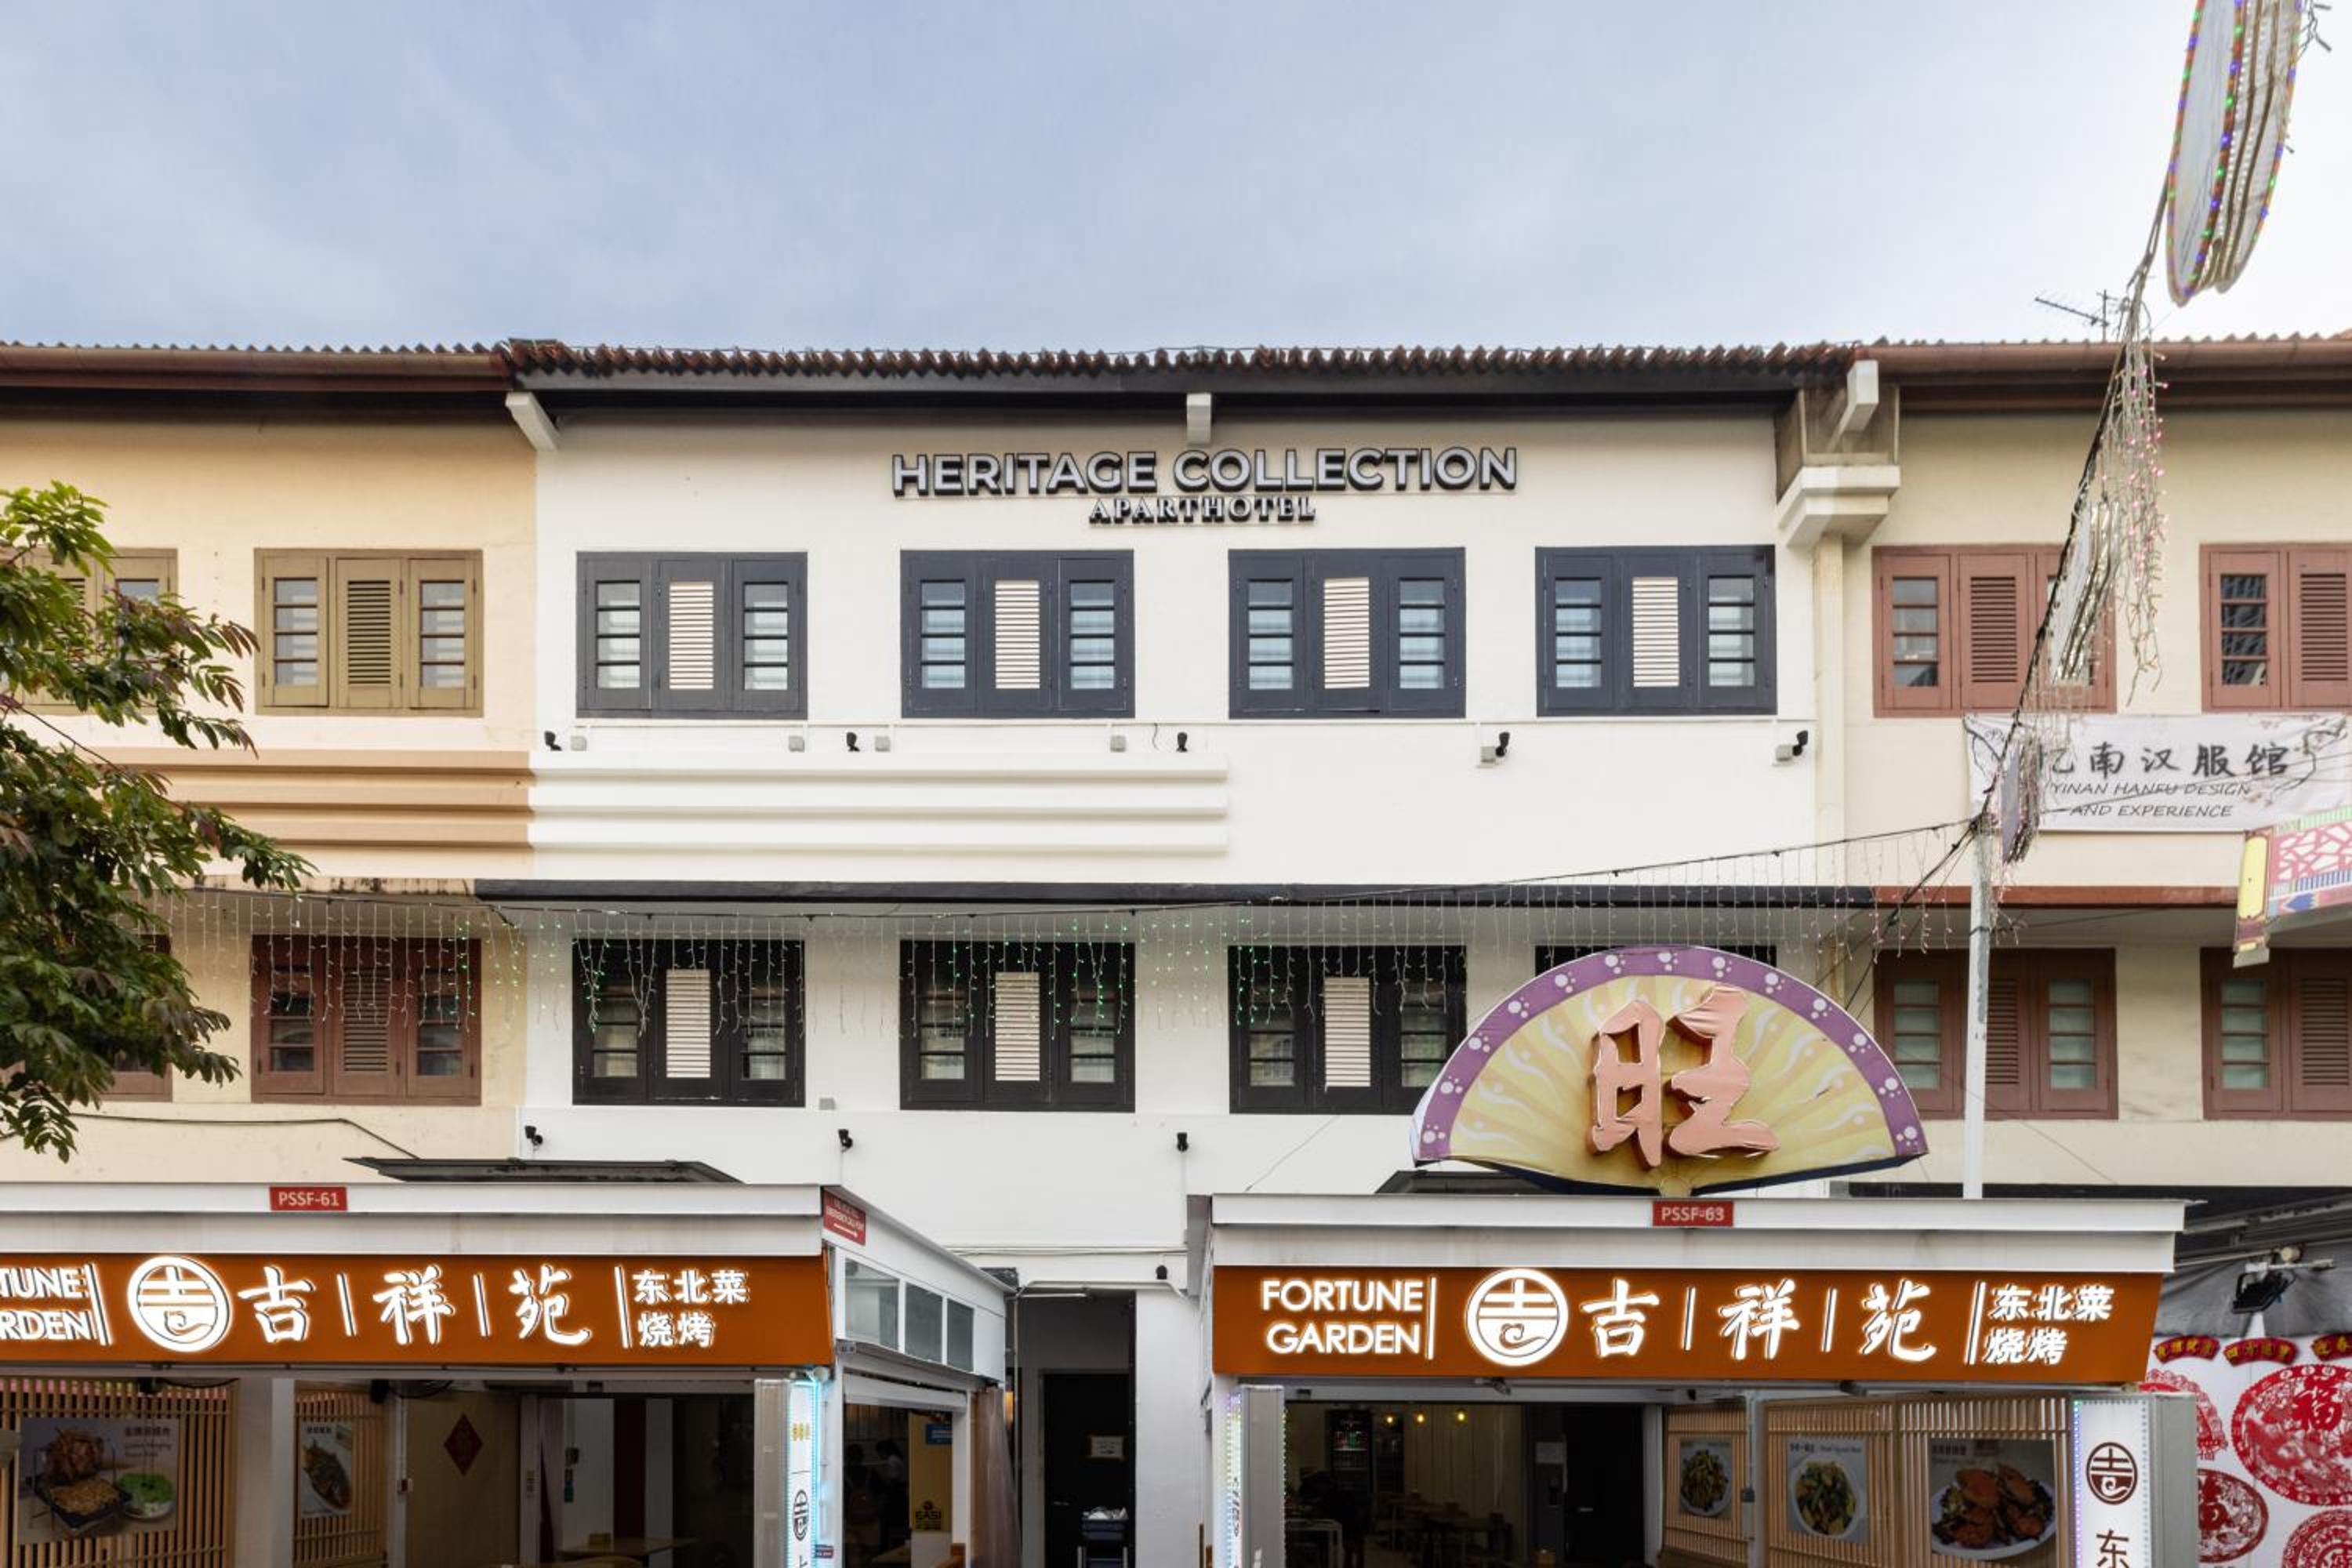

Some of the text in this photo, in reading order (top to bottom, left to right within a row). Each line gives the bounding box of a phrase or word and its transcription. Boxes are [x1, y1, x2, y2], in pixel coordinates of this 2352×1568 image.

[892, 447, 1518, 497] HERITAGE COLLECTION
[1089, 496, 1316, 524] APARTHOTEL
[2051, 783, 2250, 796] YINAN HANFU DESIGN
[2069, 804, 2234, 817] AND EXPERIENCE
[1585, 982, 1781, 1171] 旺
[278, 1191, 340, 1207] PSSF-61
[1661, 1207, 1725, 1221] PSSF-63
[633, 1269, 749, 1305] 东北菜
[1261, 1279, 1424, 1312] FORTUNE
[1987, 1284, 2115, 1321] 东北菜
[637, 1312, 715, 1348] 烧烤
[1265, 1323, 1421, 1355] GARDEN
[1983, 1328, 2068, 1365] 烧烤
